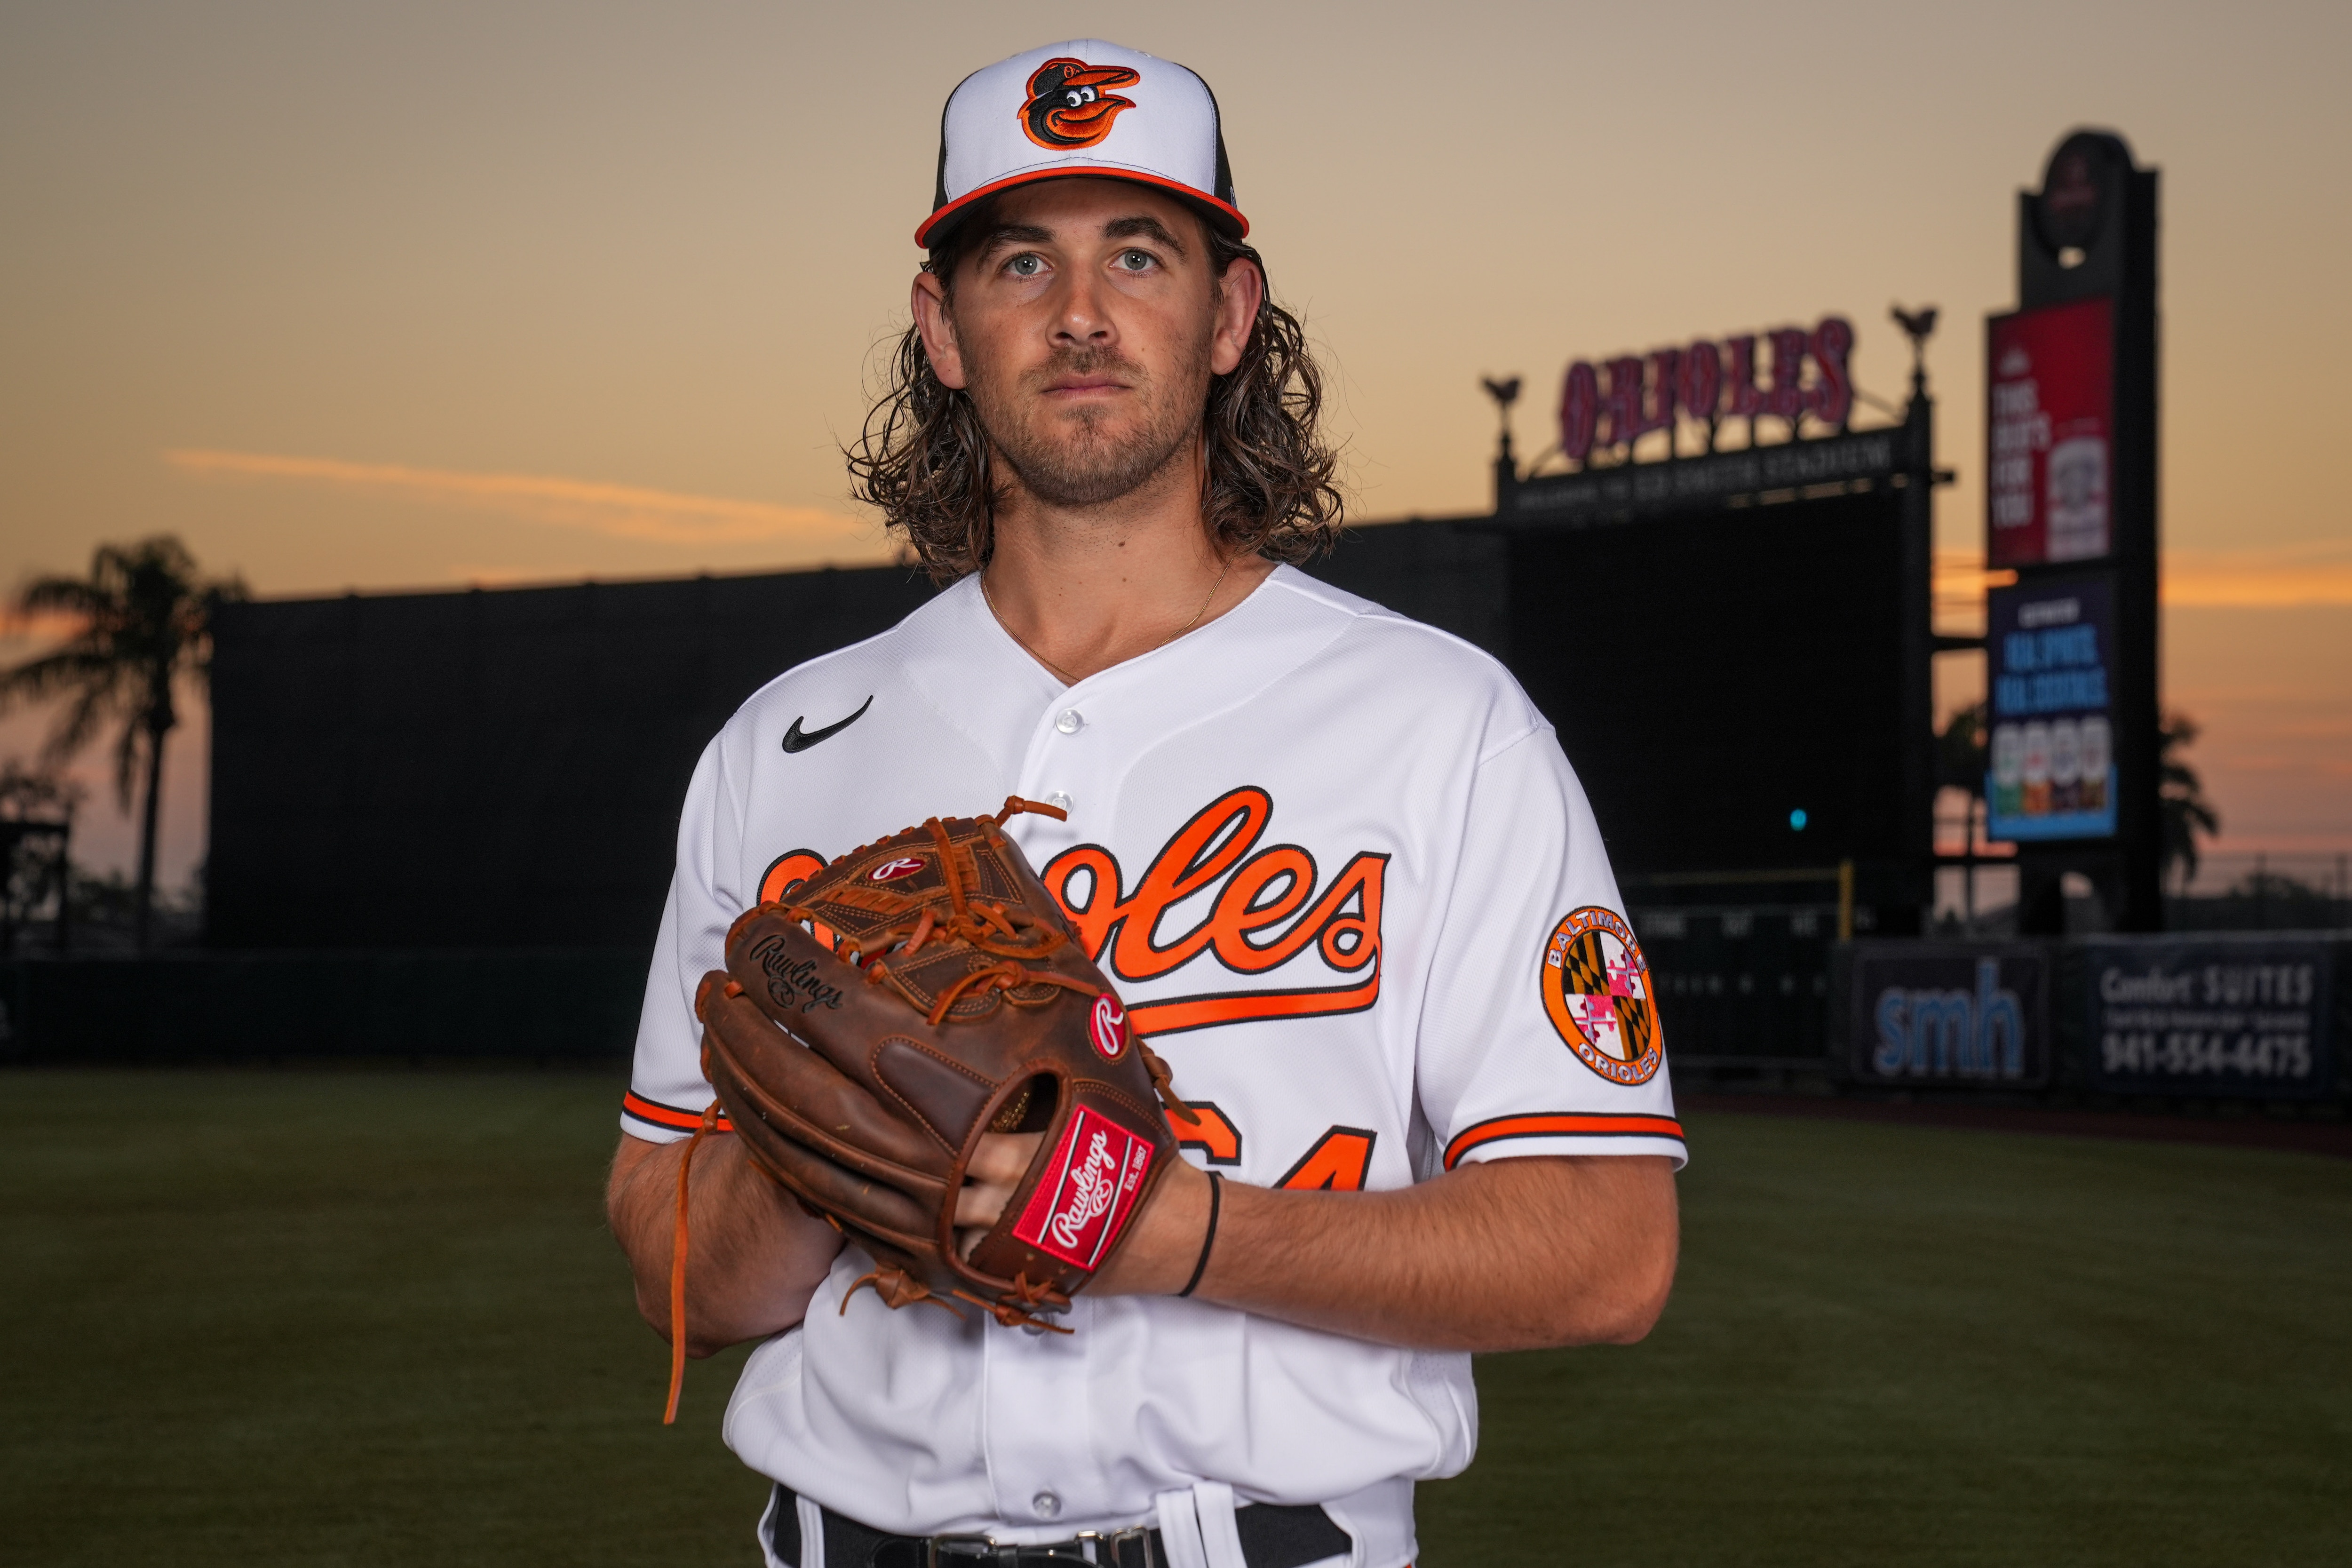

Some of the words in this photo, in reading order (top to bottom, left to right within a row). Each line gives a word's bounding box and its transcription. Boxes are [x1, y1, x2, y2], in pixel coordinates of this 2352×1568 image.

[1561, 316, 1854, 460] ORIOLES
[749, 935, 843, 1013] Rawlings
[1548, 911, 1646, 974] BALTIMORE
[1875, 955, 2024, 1077] smh
[2203, 964, 2314, 1003] SUITES
[1579, 1043, 1658, 1081] ORIOLES
[1051, 1130, 1115, 1248] Rawlings
